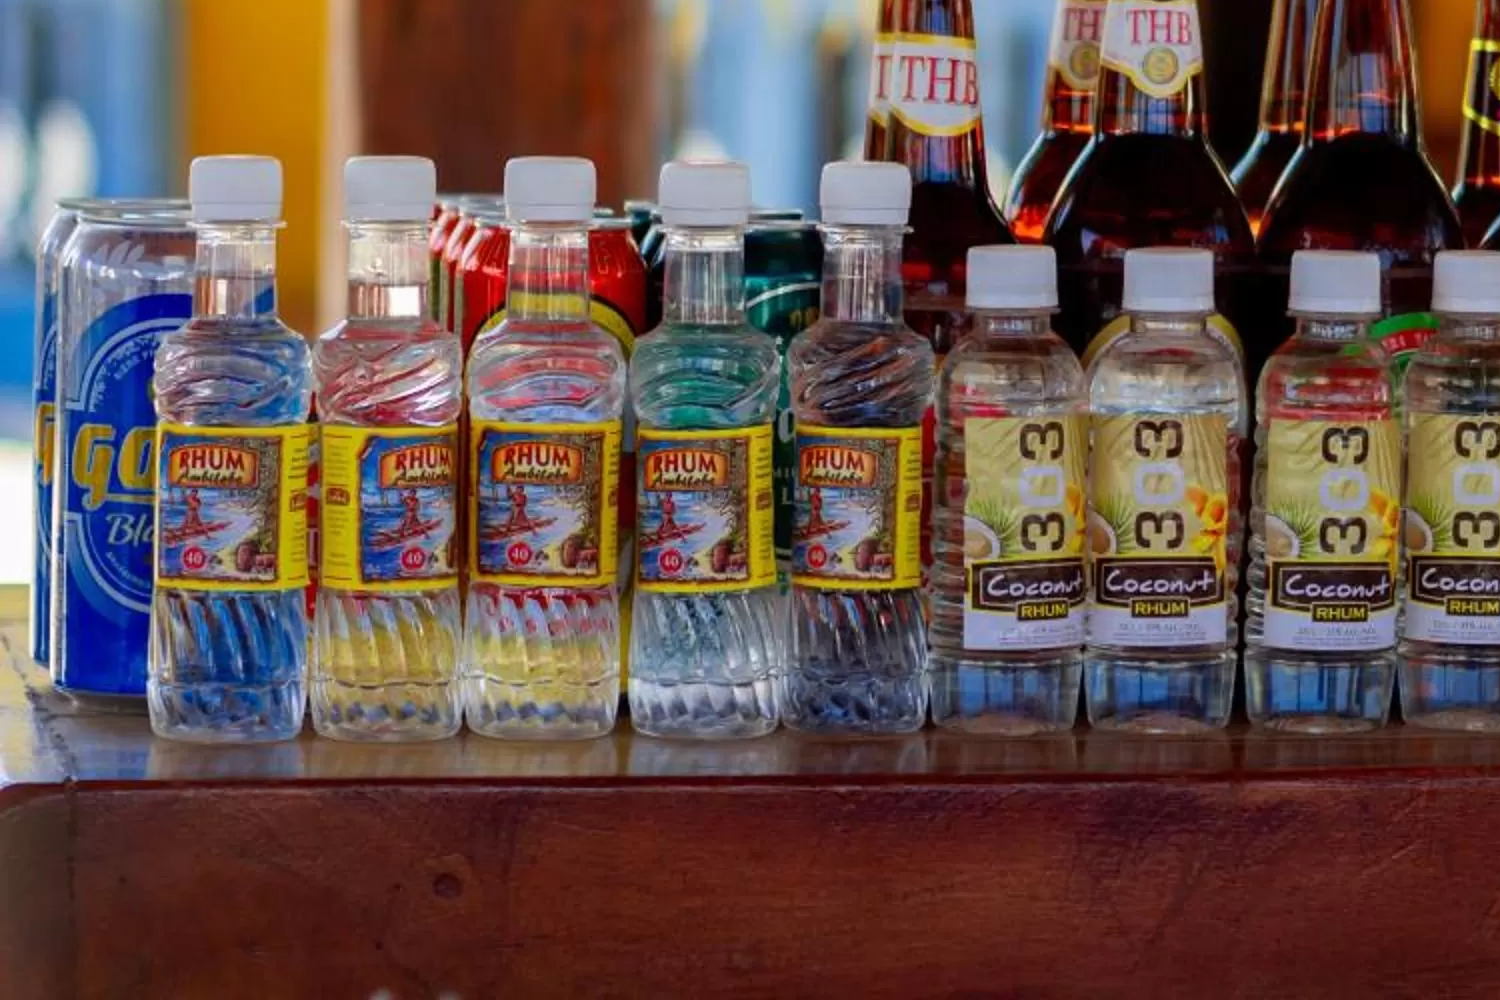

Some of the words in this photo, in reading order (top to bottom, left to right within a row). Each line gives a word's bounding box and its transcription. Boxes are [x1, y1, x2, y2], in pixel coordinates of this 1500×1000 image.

[1063, 7, 1104, 41] TH
[1127, 8, 1192, 45] THB
[902, 56, 977, 107] THB
[179, 448, 245, 471] RHUM
[395, 447, 451, 471] RHUM
[504, 445, 571, 468] RHUM
[653, 452, 717, 473] RHUM
[804, 448, 865, 472] RHUM
[987, 573, 1083, 597] Coconut
[1105, 570, 1216, 593] Coconut
[1285, 574, 1391, 597] Coconut
[1021, 602, 1067, 617] RHUM
[1134, 601, 1186, 615] RHUM
[1315, 607, 1366, 620] RHUM
[1449, 600, 1500, 614] RHUM
